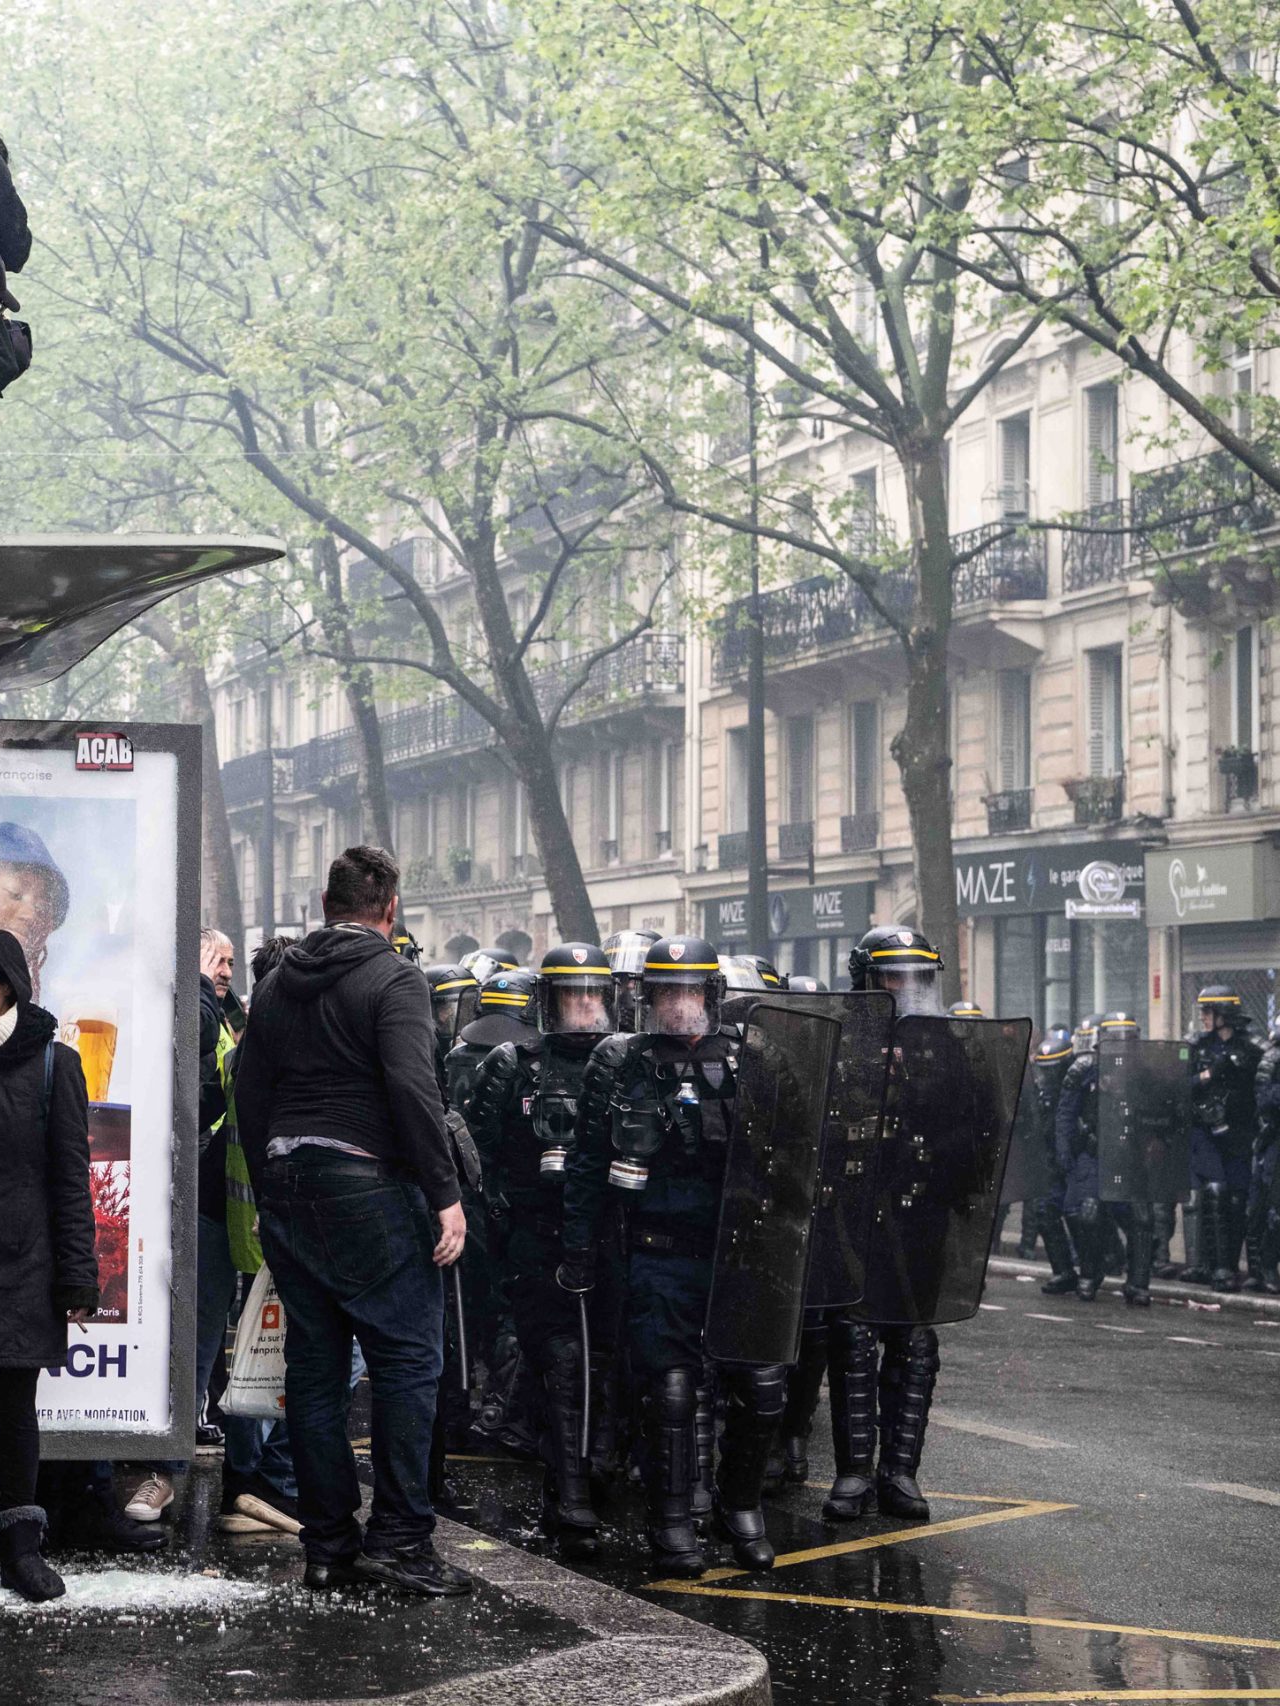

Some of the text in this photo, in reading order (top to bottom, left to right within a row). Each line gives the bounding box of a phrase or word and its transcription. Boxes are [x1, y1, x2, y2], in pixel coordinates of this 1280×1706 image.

[75, 737, 133, 764] ACAB
[956, 861, 1016, 906] MAZE
[719, 901, 746, 923] MAZE
[812, 891, 843, 915] MAZE
[97, 1307, 120, 1317] Paris
[56, 1408, 81, 1420] AVEC
[83, 1407, 150, 1422] MODÉRATION.
